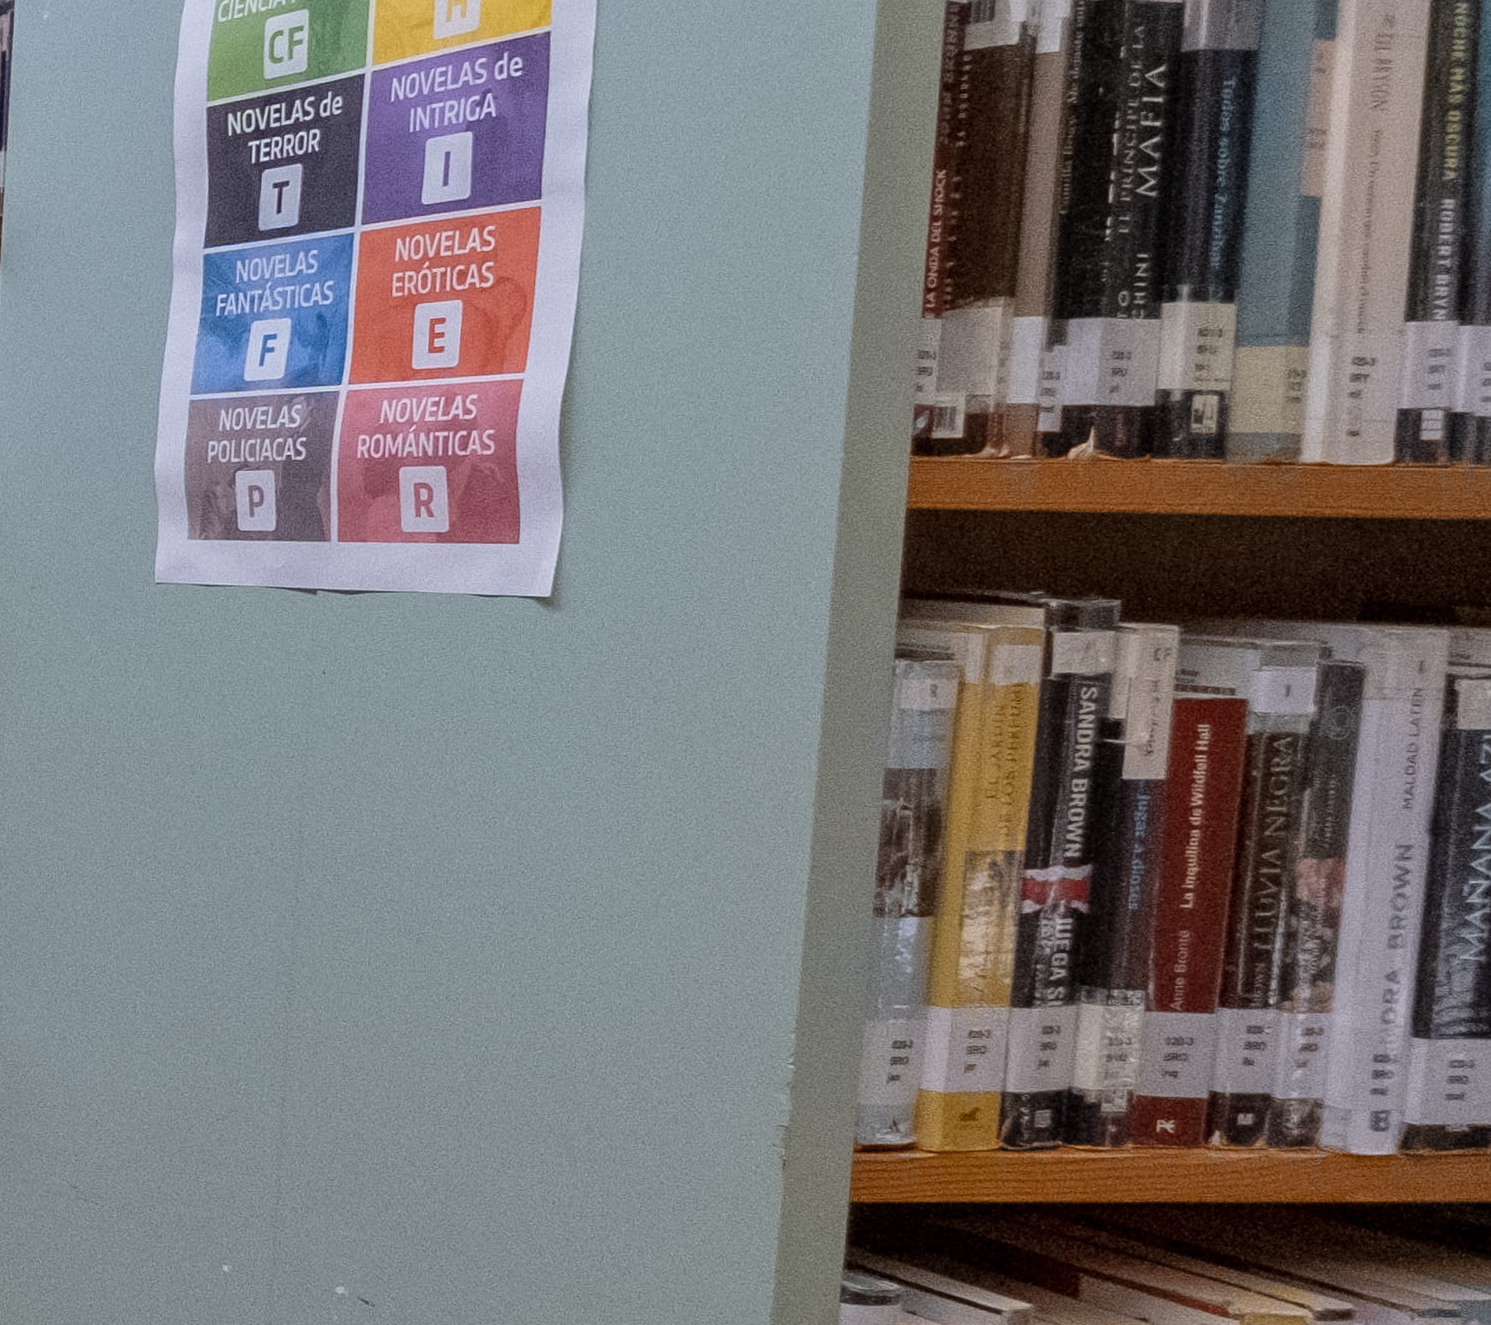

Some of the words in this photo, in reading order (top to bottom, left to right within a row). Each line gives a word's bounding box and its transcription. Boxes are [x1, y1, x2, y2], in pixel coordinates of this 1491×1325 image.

[267, 25, 305, 64] CF
[390, 57, 485, 103] NOVELAS
[494, 51, 524, 81] de
[227, 99, 314, 138] NOVELAS
[319, 88, 343, 117] de
[408, 92, 497, 133] INTRIGA
[1135, 63, 1168, 197] MAFIA
[247, 129, 321, 164] TERROR
[442, 151, 452, 187] I
[272, 180, 291, 215] T
[932, 169, 947, 217] SHOCK
[394, 225, 496, 262] NOVELAS
[930, 220, 943, 243] DEL
[235, 249, 318, 282] NOVELAS
[391, 261, 495, 298] ERÓTICAS
[926, 246, 941, 289] ONDA
[215, 280, 334, 317] FANTÁSTICAS
[258, 333, 277, 367] F
[427, 317, 446, 354] E
[219, 404, 302, 431] NOVELAS
[379, 394, 478, 424] NOVELAS
[207, 437, 307, 464] POLICIACAS
[357, 425, 496, 460] ROMÁNTICAS
[248, 484, 264, 519] P
[414, 482, 435, 518] R
[1071, 686, 1099, 772] SANDRA
[1194, 722, 1211, 751] Hall
[1189, 754, 1208, 807] Wildfell
[1063, 778, 1090, 858] BROWN
[1178, 892, 1194, 910] La
